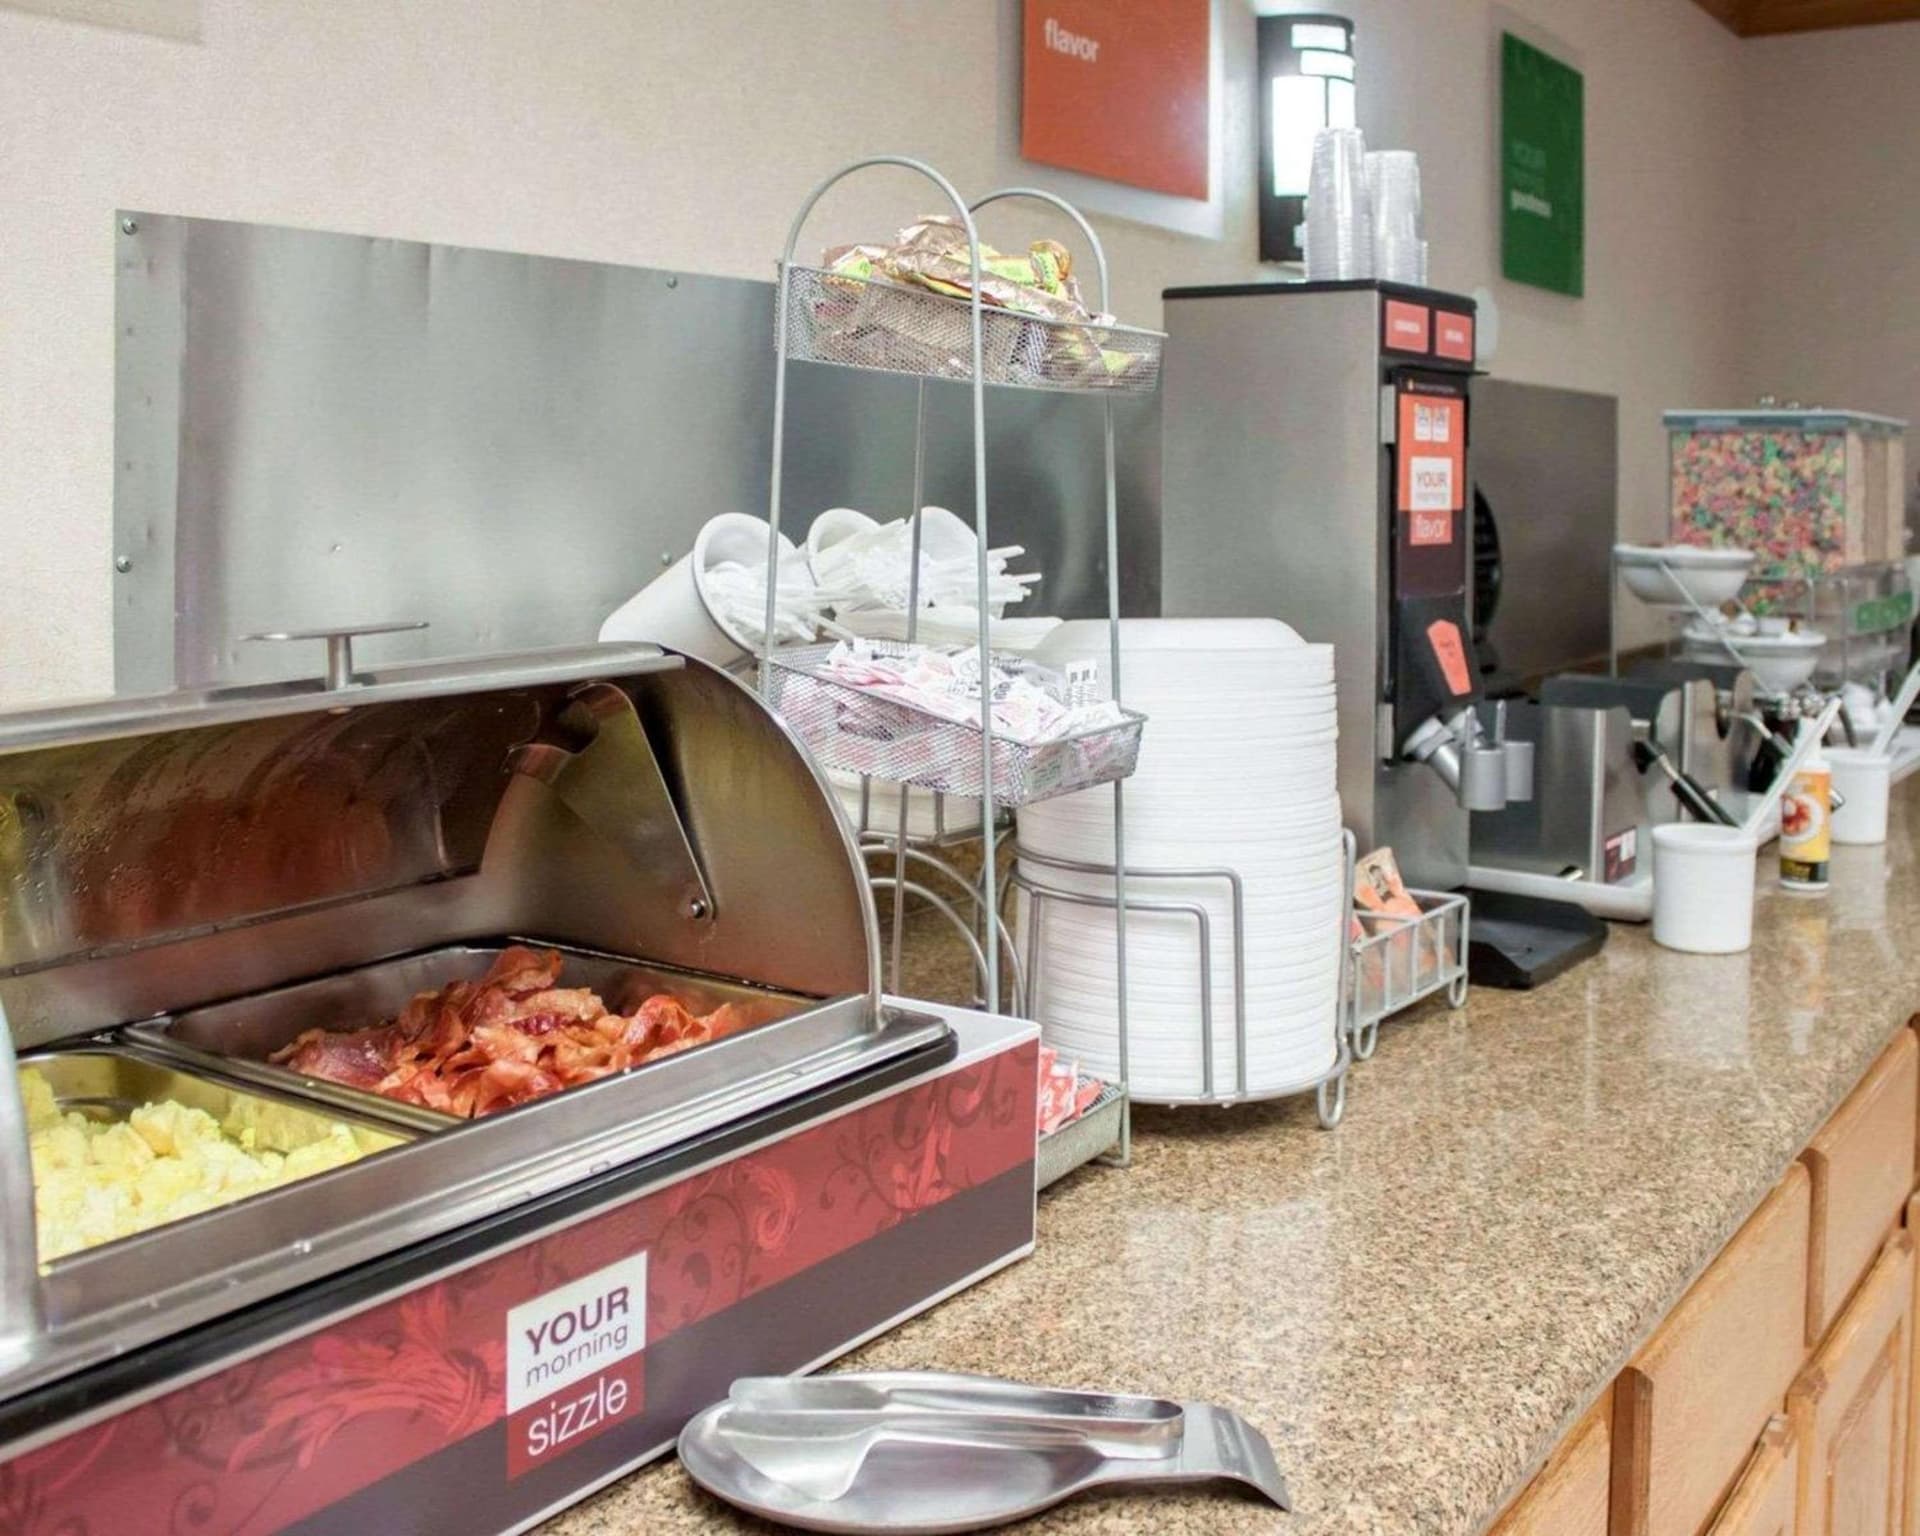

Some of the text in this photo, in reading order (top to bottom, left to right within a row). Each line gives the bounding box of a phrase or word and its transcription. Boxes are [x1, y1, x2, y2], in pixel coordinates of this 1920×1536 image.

[1045, 18, 1099, 63] flavor
[1416, 471, 1449, 488] YOUR
[525, 1286, 629, 1355] YOUR
[526, 1324, 628, 1387] morning
[528, 1377, 627, 1456] sizzle
